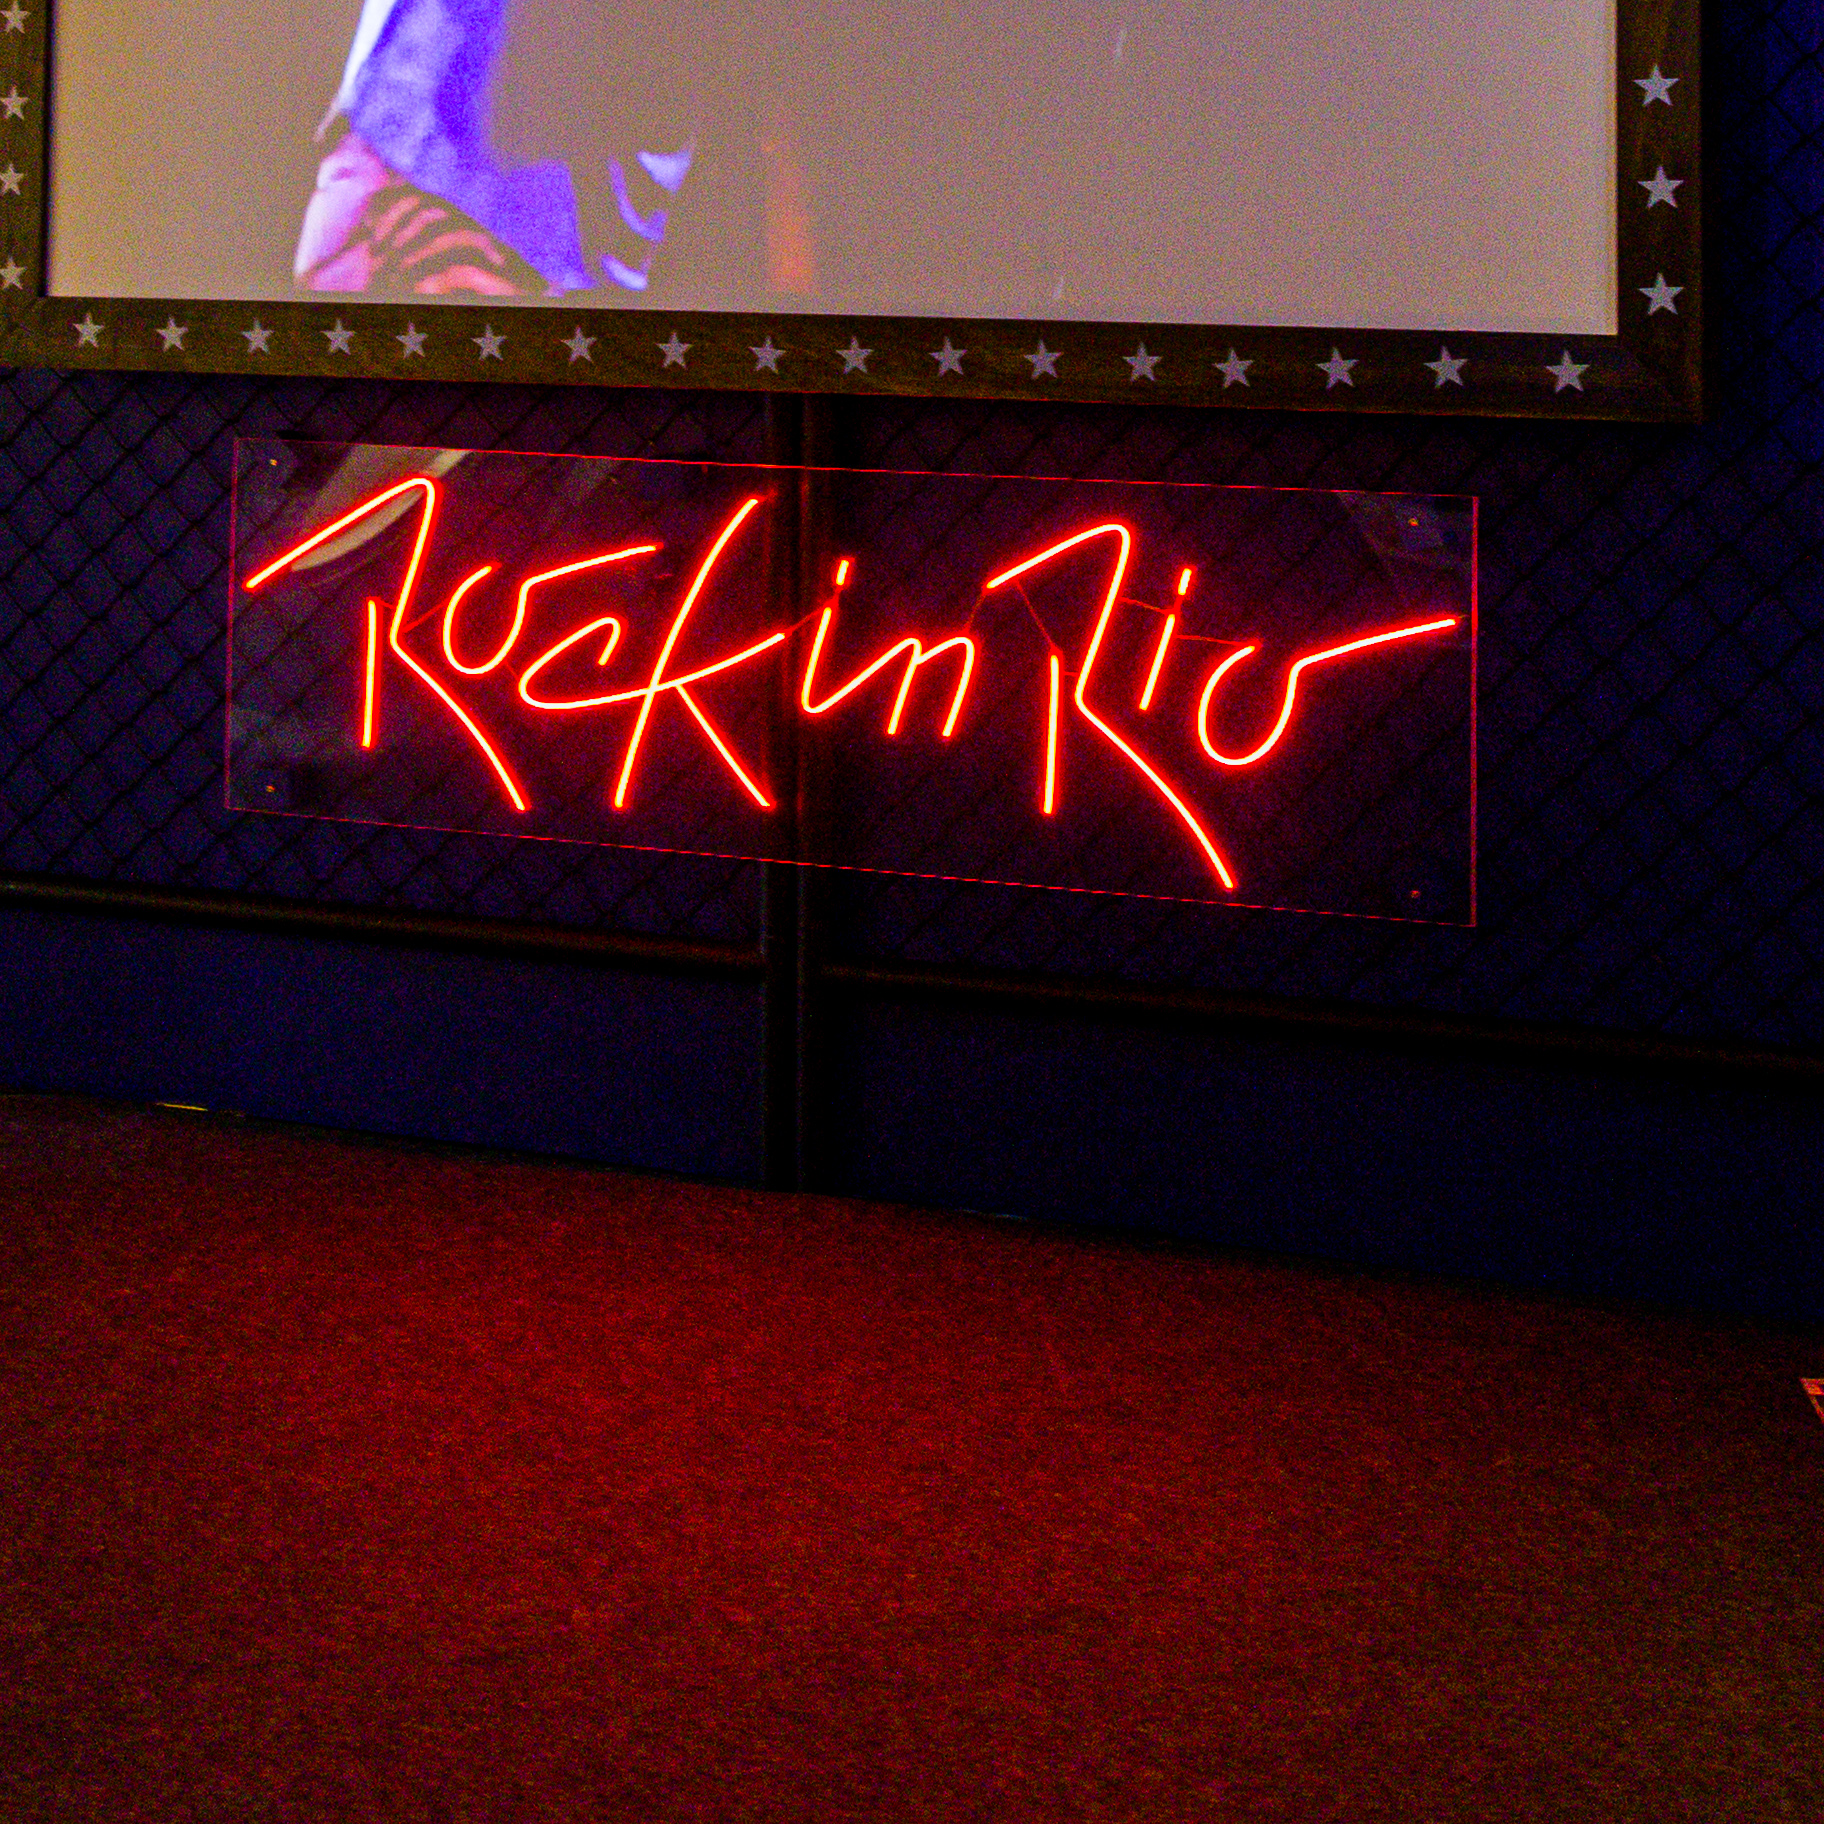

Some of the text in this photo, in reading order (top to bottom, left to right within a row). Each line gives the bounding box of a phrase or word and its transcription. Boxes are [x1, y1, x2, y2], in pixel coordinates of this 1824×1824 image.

[242, 474, 1462, 892] Rock in Rio
